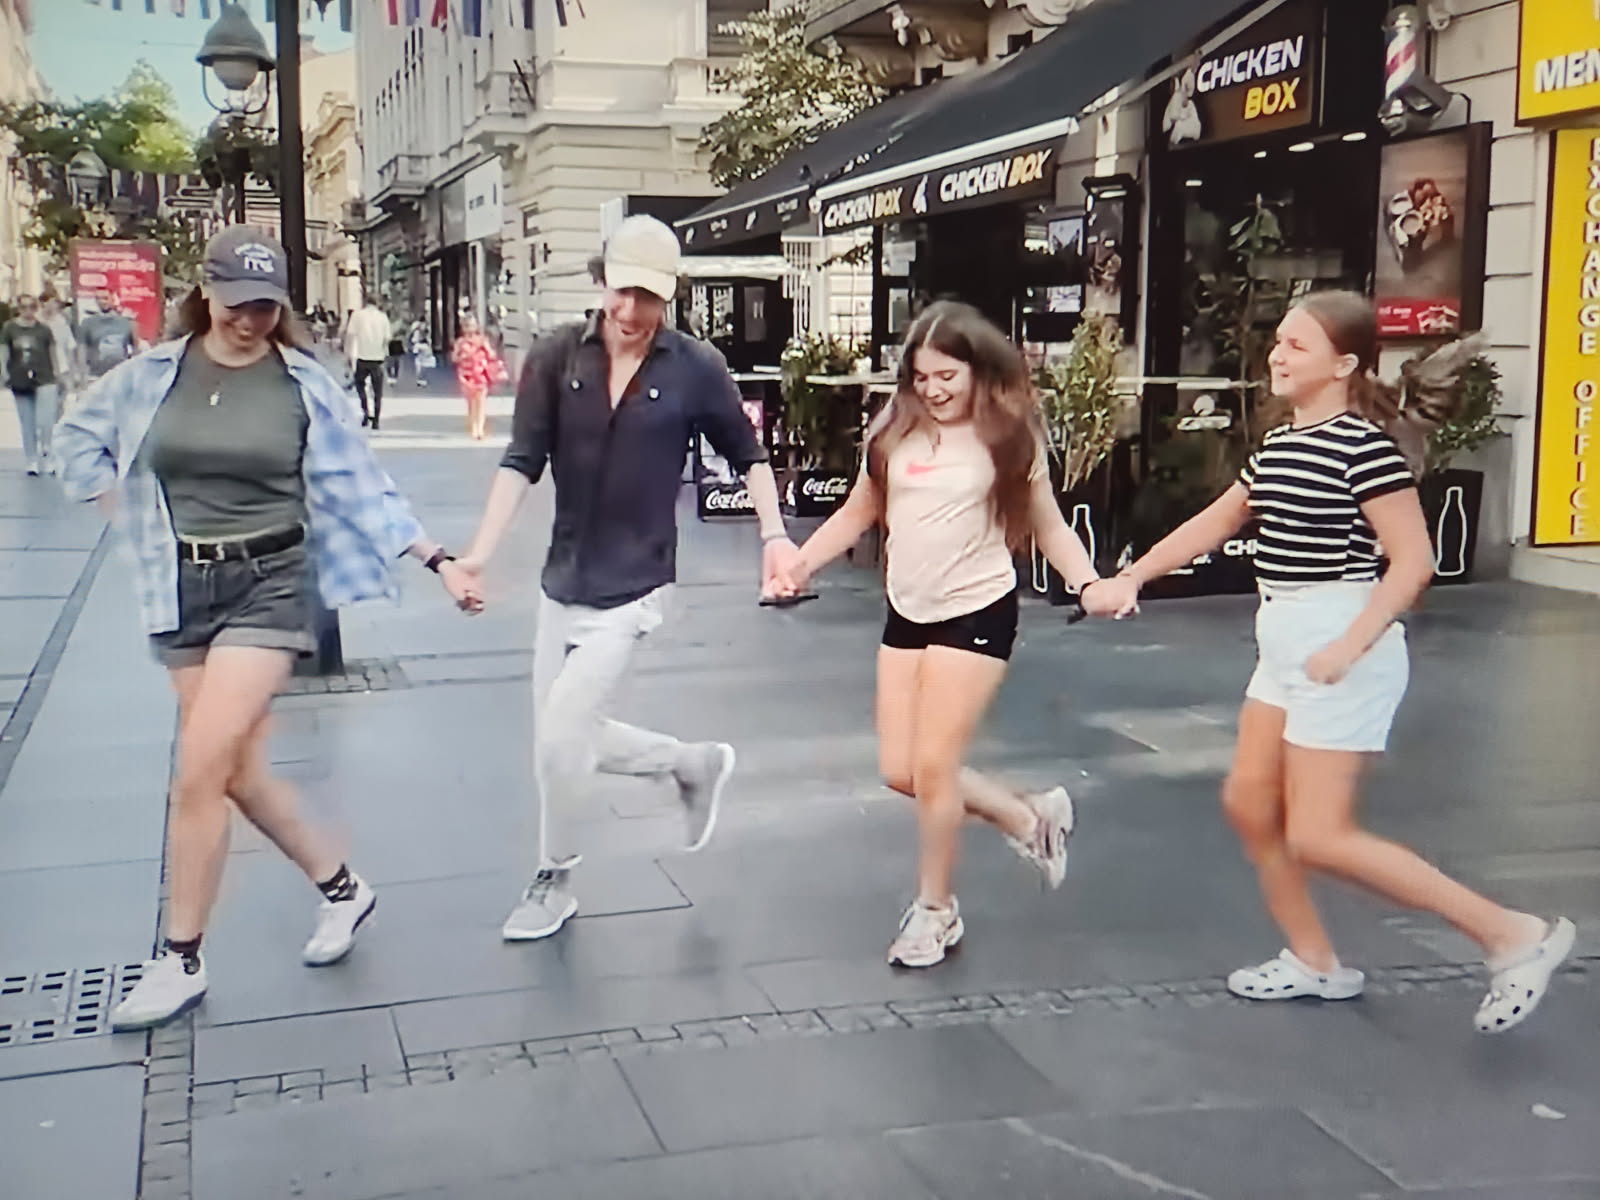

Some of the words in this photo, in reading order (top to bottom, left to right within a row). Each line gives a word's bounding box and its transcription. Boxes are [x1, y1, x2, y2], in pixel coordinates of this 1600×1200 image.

[1197, 35, 1303, 92] CHICKEN
[1244, 77, 1300, 120] BOX
[1571, 379, 1597, 536] OFFICE
